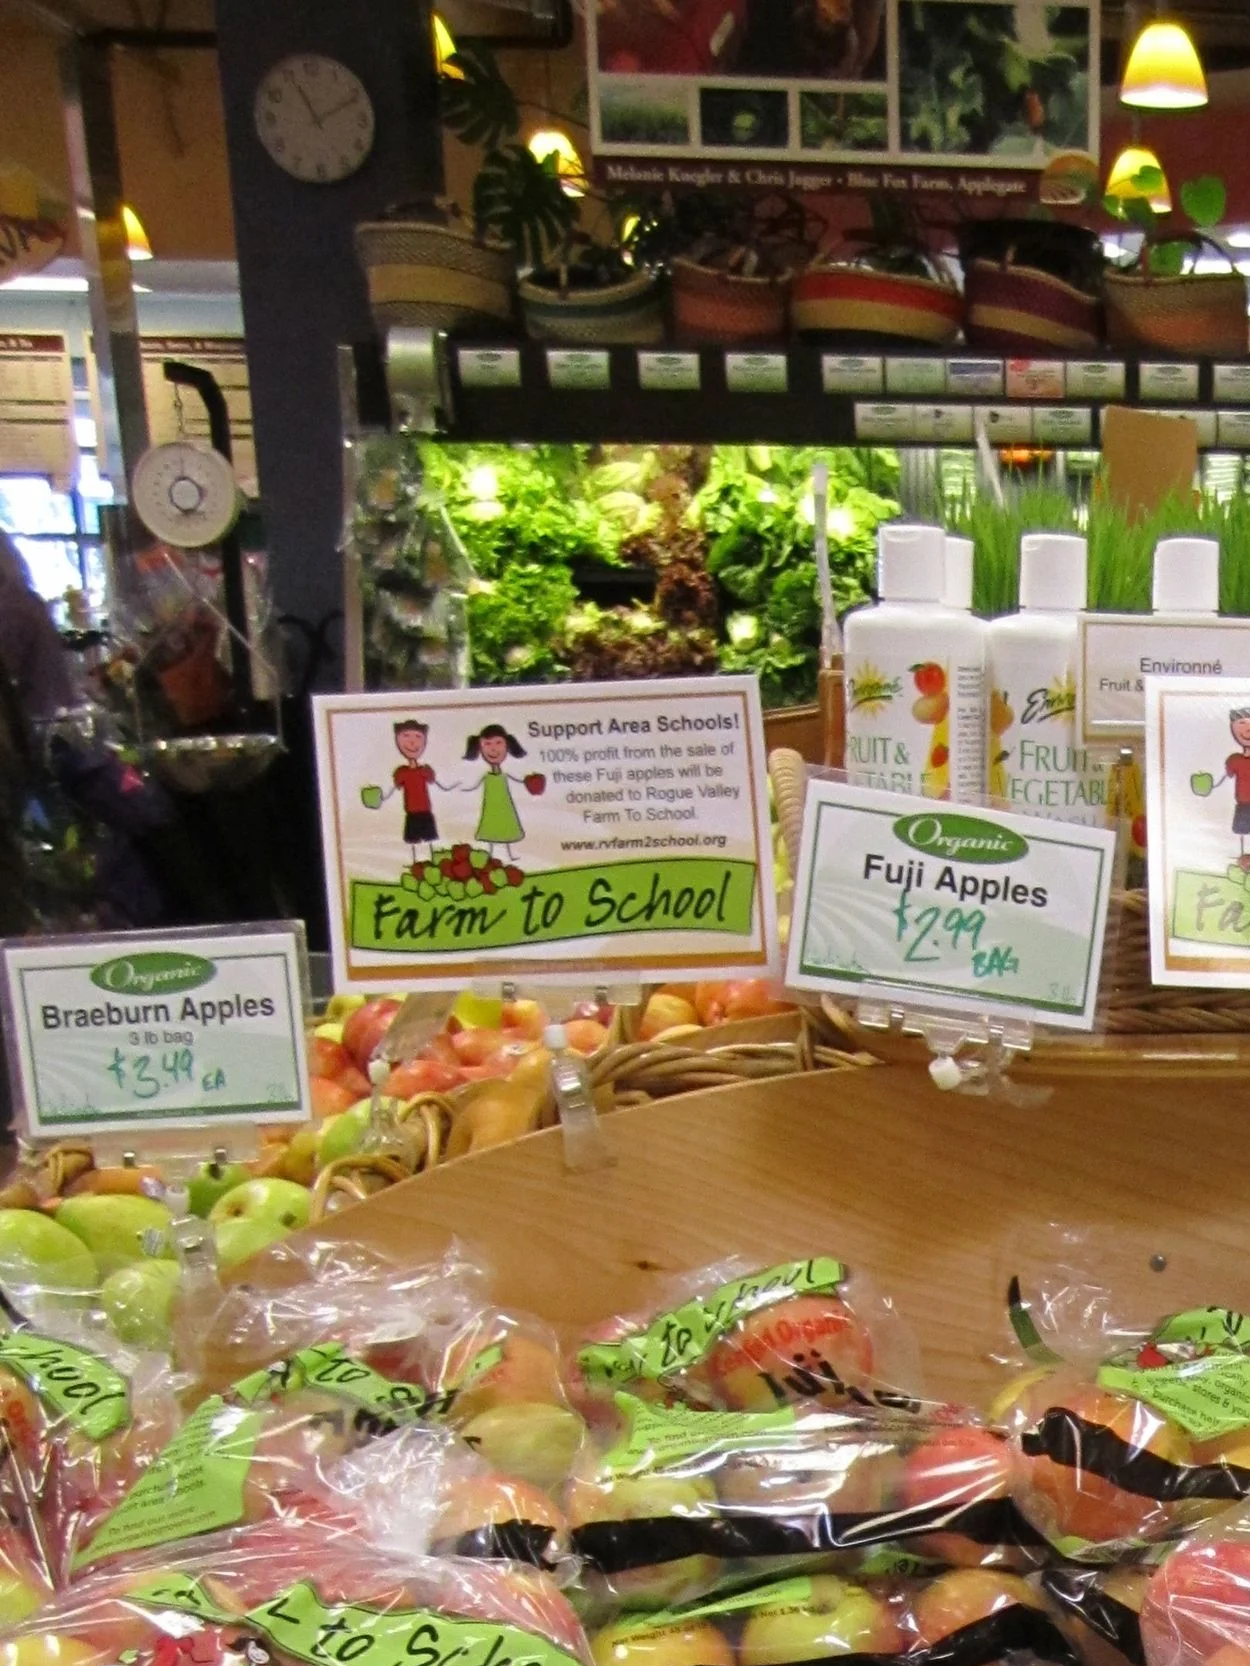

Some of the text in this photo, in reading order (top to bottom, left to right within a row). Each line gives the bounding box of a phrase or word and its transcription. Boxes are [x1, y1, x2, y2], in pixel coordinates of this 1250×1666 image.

[728, 169, 741, 184] &
[745, 168, 785, 186] Chris
[1139, 656, 1224, 675] Environné
[1099, 677, 1131, 692] Fruit
[528, 712, 740, 740] Support Area Schools!
[539, 741, 735, 765] 100% profit from the sale of
[894, 742, 910, 765] &
[552, 762, 723, 785] these Fuji apples will be
[565, 783, 741, 804] donated to Rogue Valley
[583, 808, 621, 825] Farm
[624, 807, 642, 823] To
[560, 833, 727, 851] www.rvfarm2school.org
[908, 816, 1015, 857] Organic
[863, 852, 1049, 908] Fuji Apples
[373, 870, 732, 941] Farm to School
[893, 887, 987, 963] $2.99
[103, 960, 203, 992] Organic
[41, 993, 276, 1031] Braeburn Apples
[128, 1030, 195, 1047] 3 lb bag
[661, 1322, 693, 1367] to
[314, 1619, 375, 1662] to
